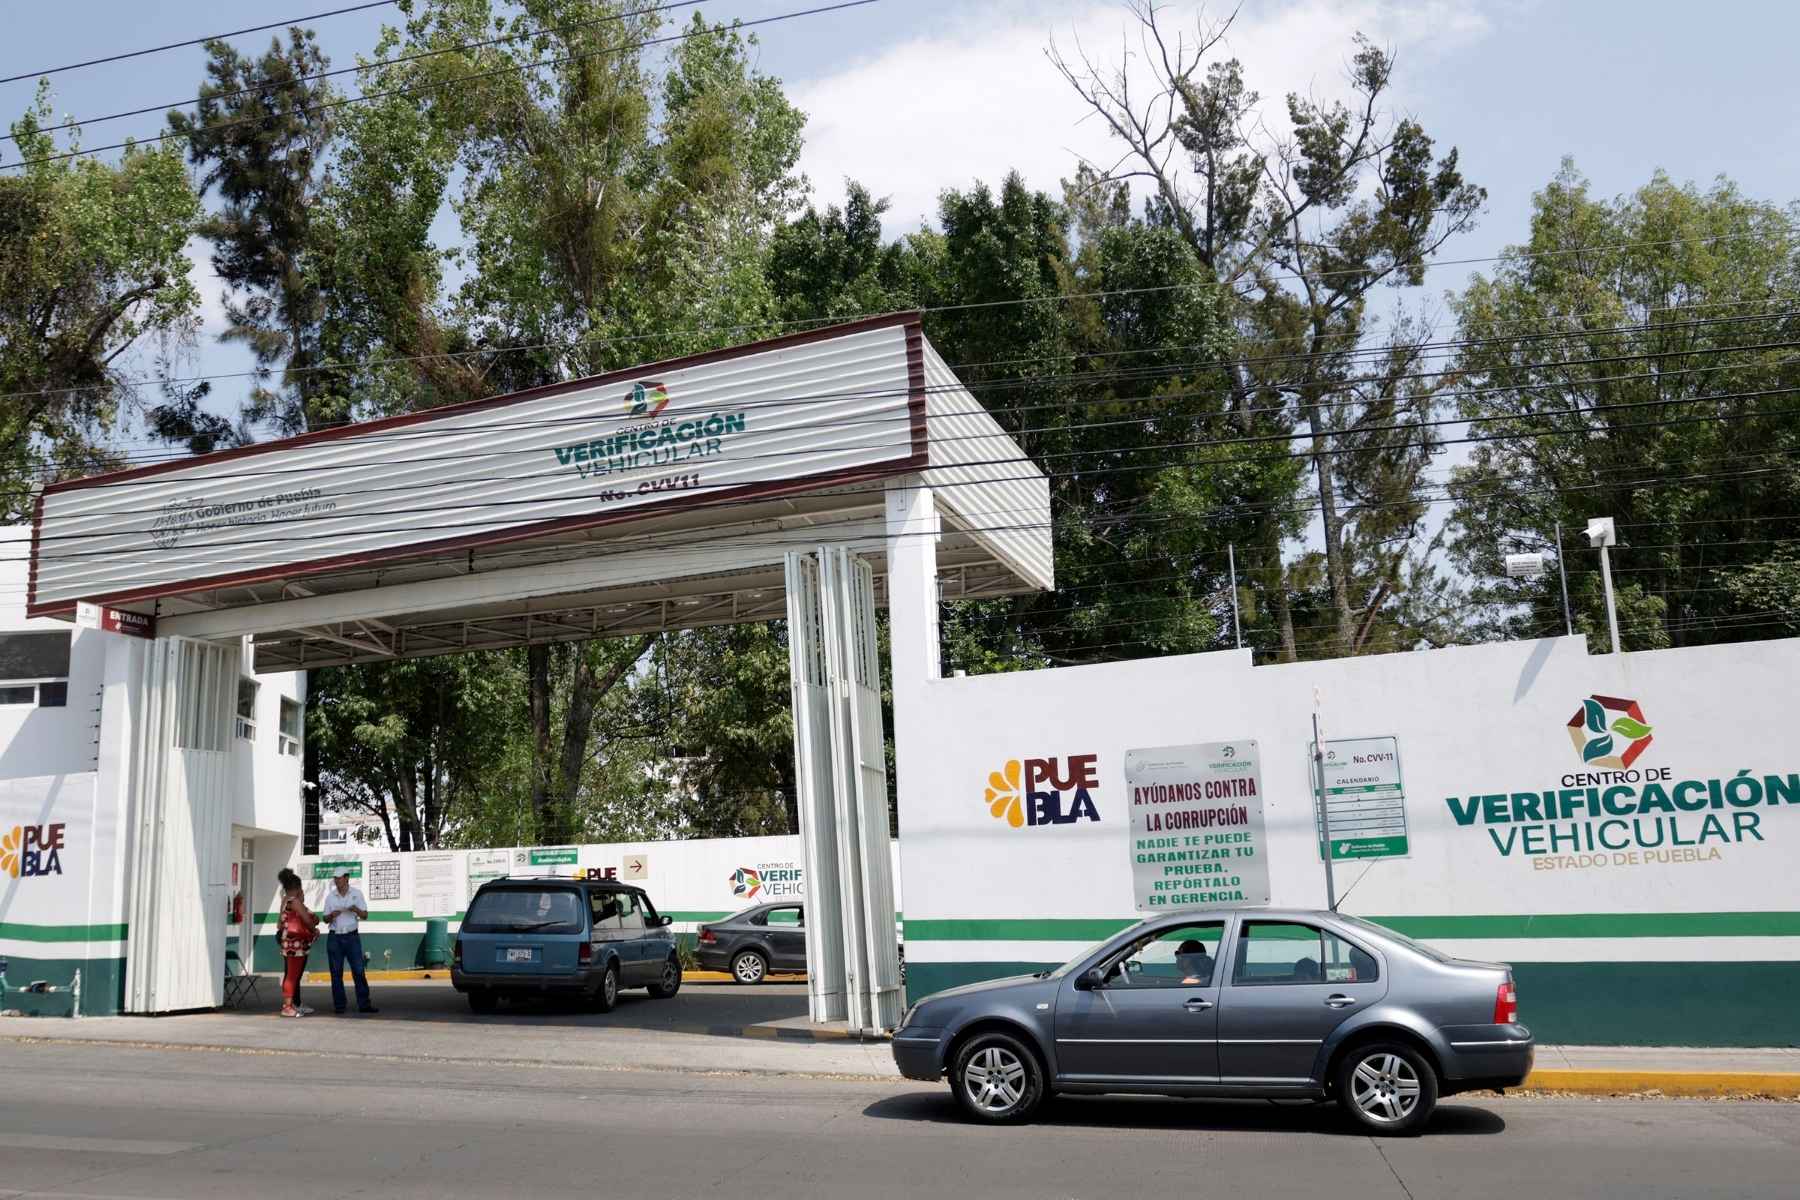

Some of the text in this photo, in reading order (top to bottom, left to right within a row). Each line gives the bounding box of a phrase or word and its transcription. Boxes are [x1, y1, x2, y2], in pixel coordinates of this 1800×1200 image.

[555, 413, 746, 465] VERIFICACIÓN
[576, 438, 722, 479] VEHICULAR
[110, 610, 149, 625] ENTRADA
[1367, 753, 1394, 763] CVV-11
[1024, 754, 1100, 793] PUE
[1336, 776, 1380, 785] CALENDARIO
[1561, 767, 1672, 788] CENTRO DE
[1134, 778, 1257, 806] AYÚDANOS CONTRA
[1445, 769, 1800, 826] VERIFICACIÓN
[1027, 788, 1101, 826] BLA
[1146, 804, 1248, 832] LA CORRUPCIÓN
[23, 823, 66, 851] PUE
[1136, 832, 1253, 850] NADIE TE PUEDE
[1488, 811, 1765, 857] VEHICULAR
[20, 847, 63, 877] BLA
[1136, 847, 1254, 864] GARANTIZAR TU
[1533, 847, 1722, 870] ESTADO DE PUEBLA
[586, 867, 617, 880] PUE
[1164, 863, 1228, 876] PRUEBA.
[763, 882, 804, 896] VEHIC
[1154, 875, 1241, 891] REPÓRTALO
[1149, 891, 1249, 906] EN GERENCIA.
